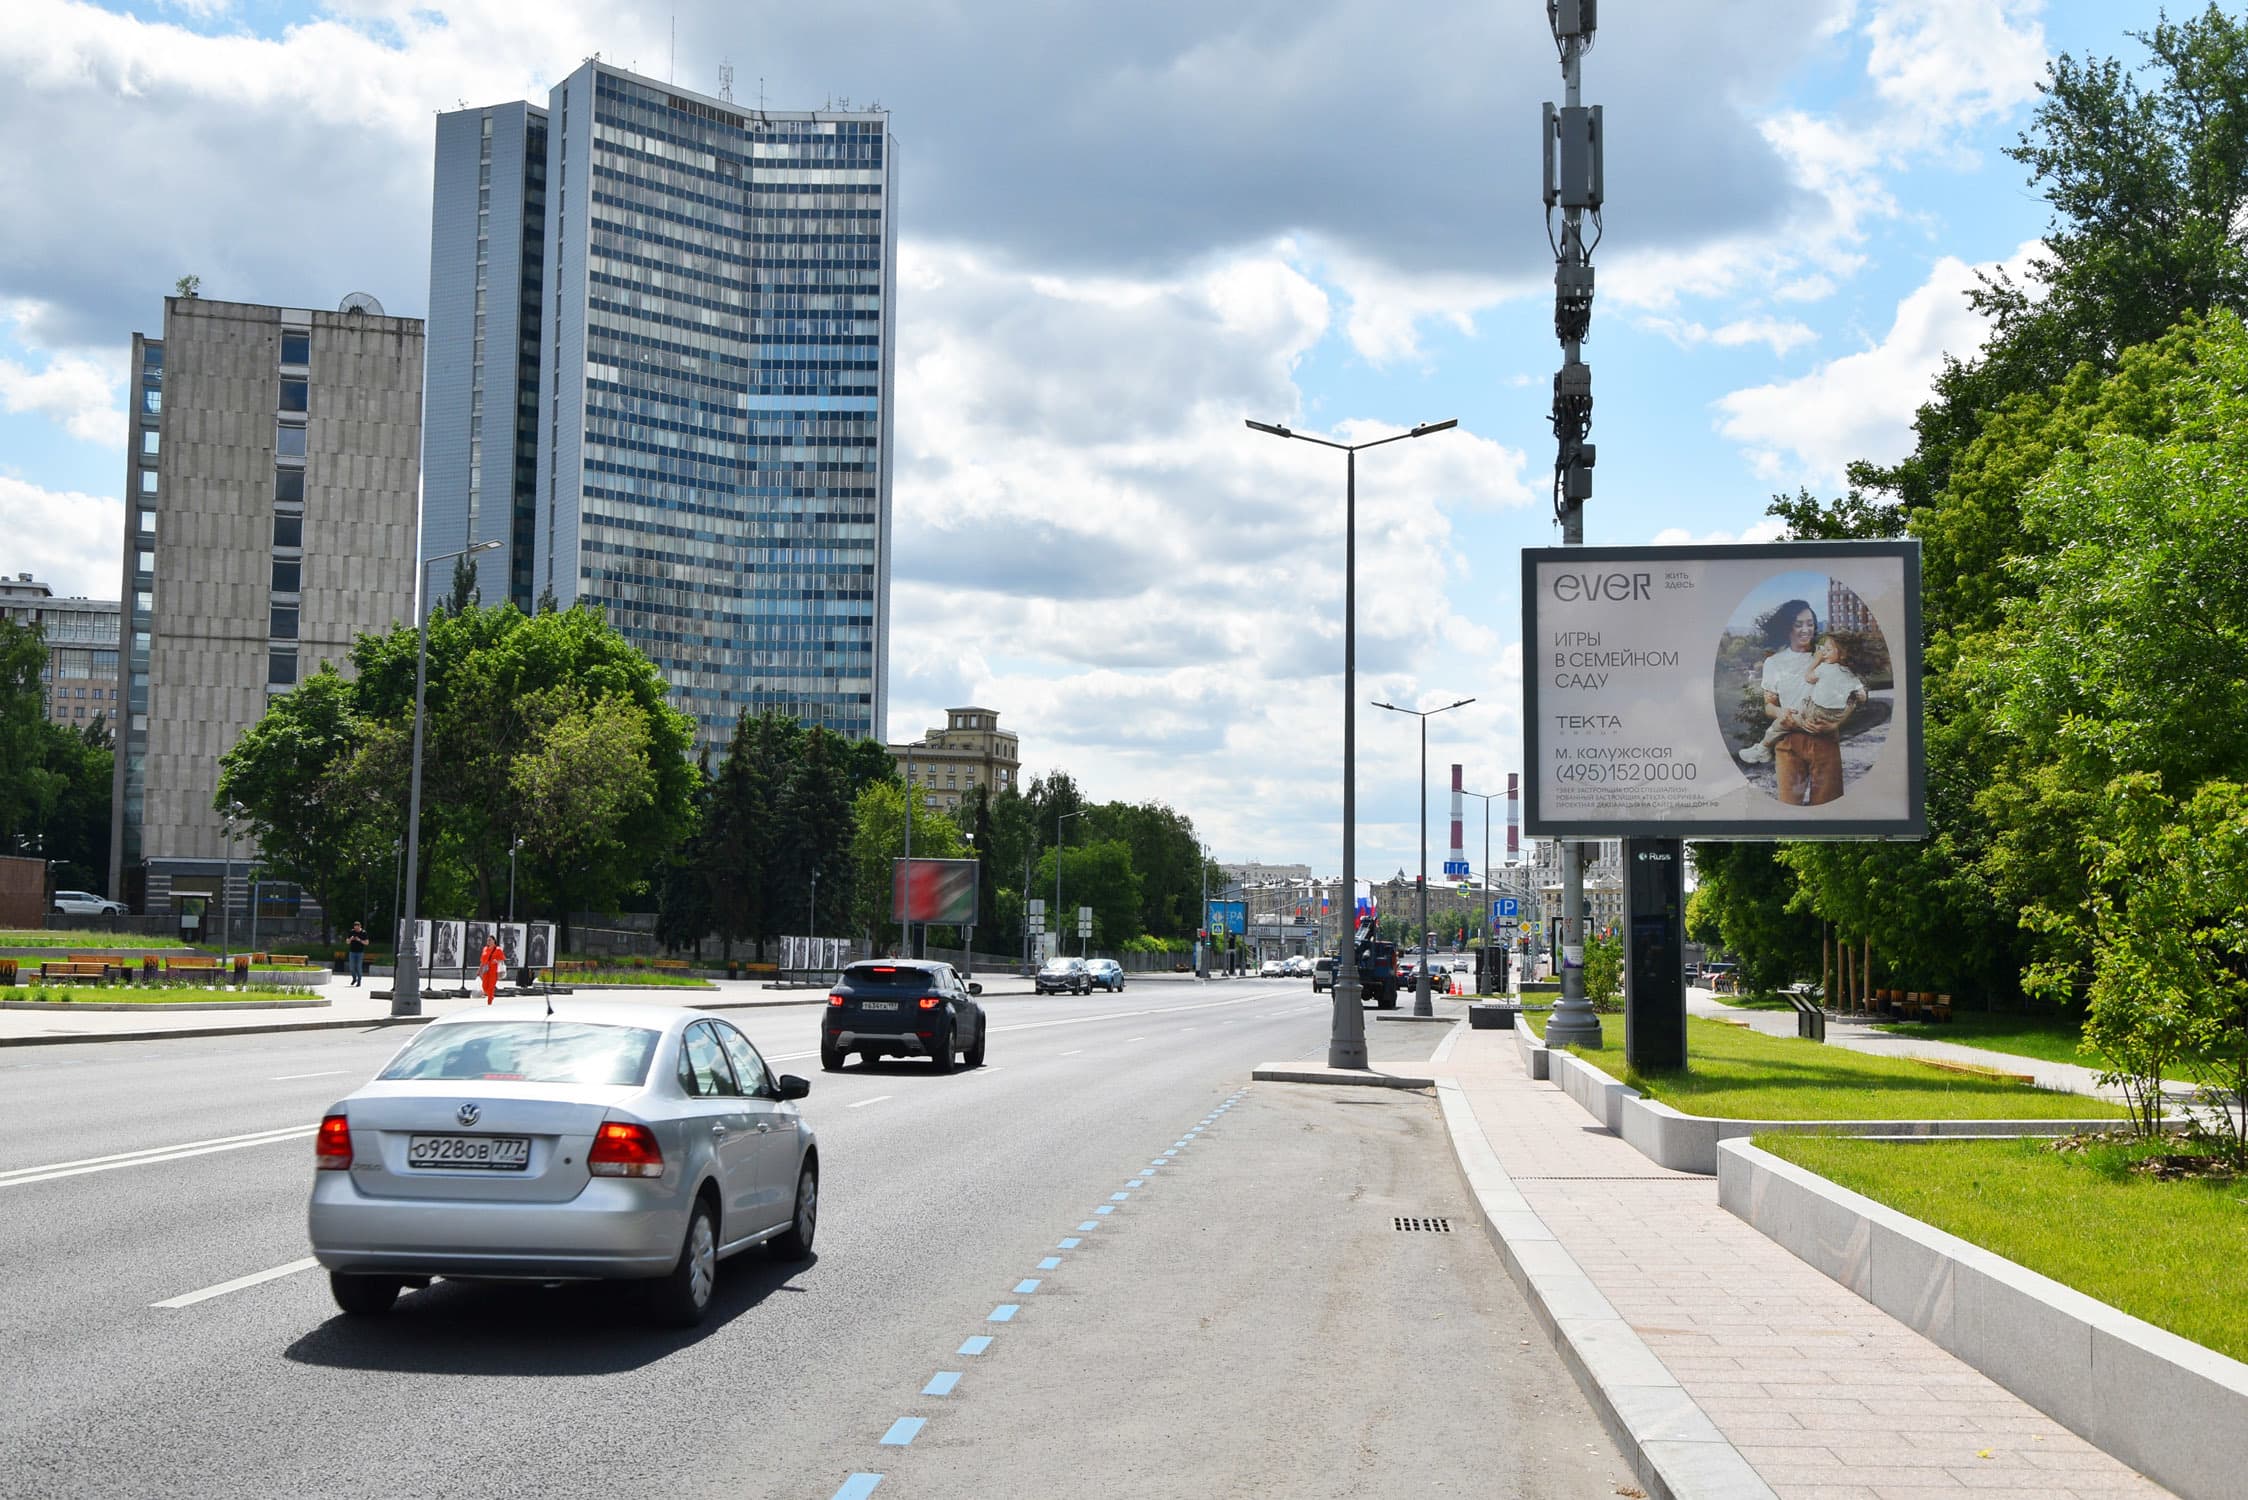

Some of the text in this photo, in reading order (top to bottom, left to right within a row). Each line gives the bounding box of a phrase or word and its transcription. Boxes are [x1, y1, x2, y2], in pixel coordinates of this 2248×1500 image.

[1555, 631, 1601, 647] ИГРЫ
[1555, 648, 1679, 668] В СЕМЕЙНОМ
[1555, 672, 1609, 690] САДУ
[1555, 715, 1622, 729] ТЕКТА
[1577, 747, 1672, 762] калужская
[1649, 852, 1672, 861] Russ
